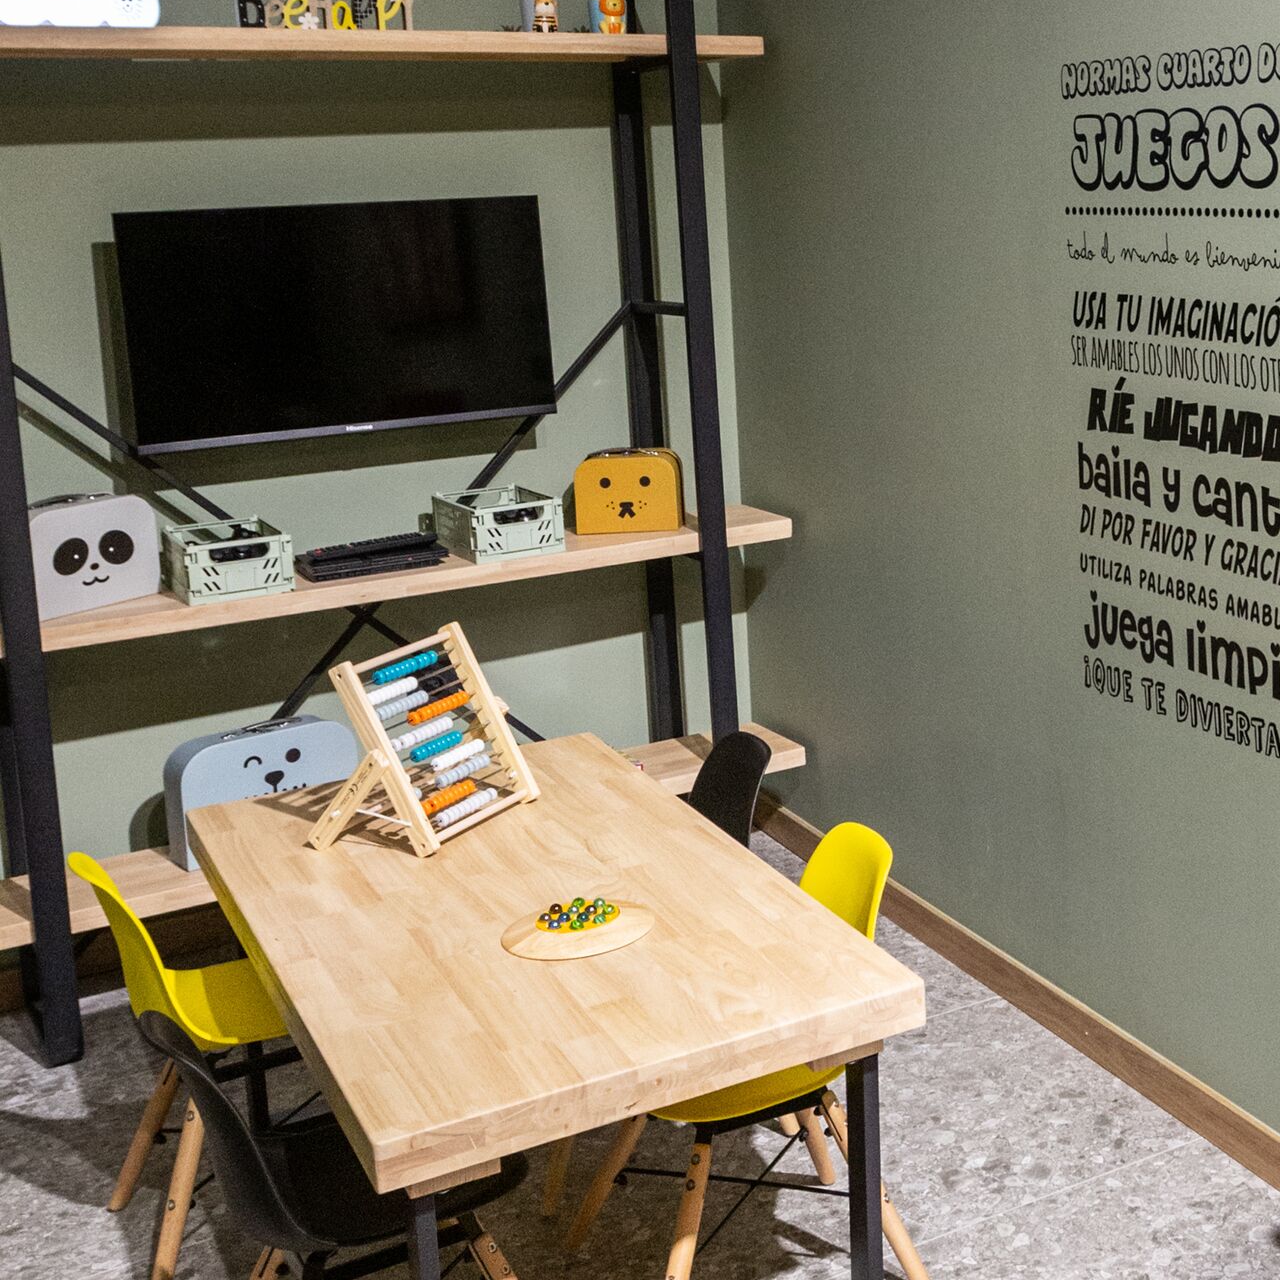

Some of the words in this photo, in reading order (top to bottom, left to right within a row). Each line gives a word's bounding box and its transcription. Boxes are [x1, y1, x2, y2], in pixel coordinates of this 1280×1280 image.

[1060, 54, 1151, 100] NORMAS
[1156, 44, 1252, 91] CUARTO
[1070, 103, 1280, 192] JUEGOS
[1067, 230, 1097, 261] todo
[1101, 232, 1116, 264] el
[1120, 232, 1180, 265] mundo
[1185, 249, 1201, 266] es
[1073, 291, 1107, 330] USA
[1117, 294, 1143, 332] TU
[1071, 335, 1089, 368] SER
[1090, 337, 1141, 374] AMABLES
[1142, 342, 1163, 377] LOS
[1164, 345, 1199, 381] UNOS
[1202, 349, 1230, 386] CON
[1233, 353, 1257, 390] LOS
[1087, 376, 1136, 434] RÍE
[1077, 441, 1152, 508] baila
[1162, 466, 1181, 513] y
[1080, 503, 1097, 536] DI
[1101, 509, 1136, 545] POR
[1140, 518, 1198, 562] FAVOR
[1204, 533, 1217, 567] Y
[1079, 552, 1133, 587] UTILIZA
[1138, 569, 1219, 611] PALABRAS
[1084, 589, 1175, 668] juega
[1083, 654, 1134, 704] ¡QUE
[1141, 677, 1168, 716] TE
